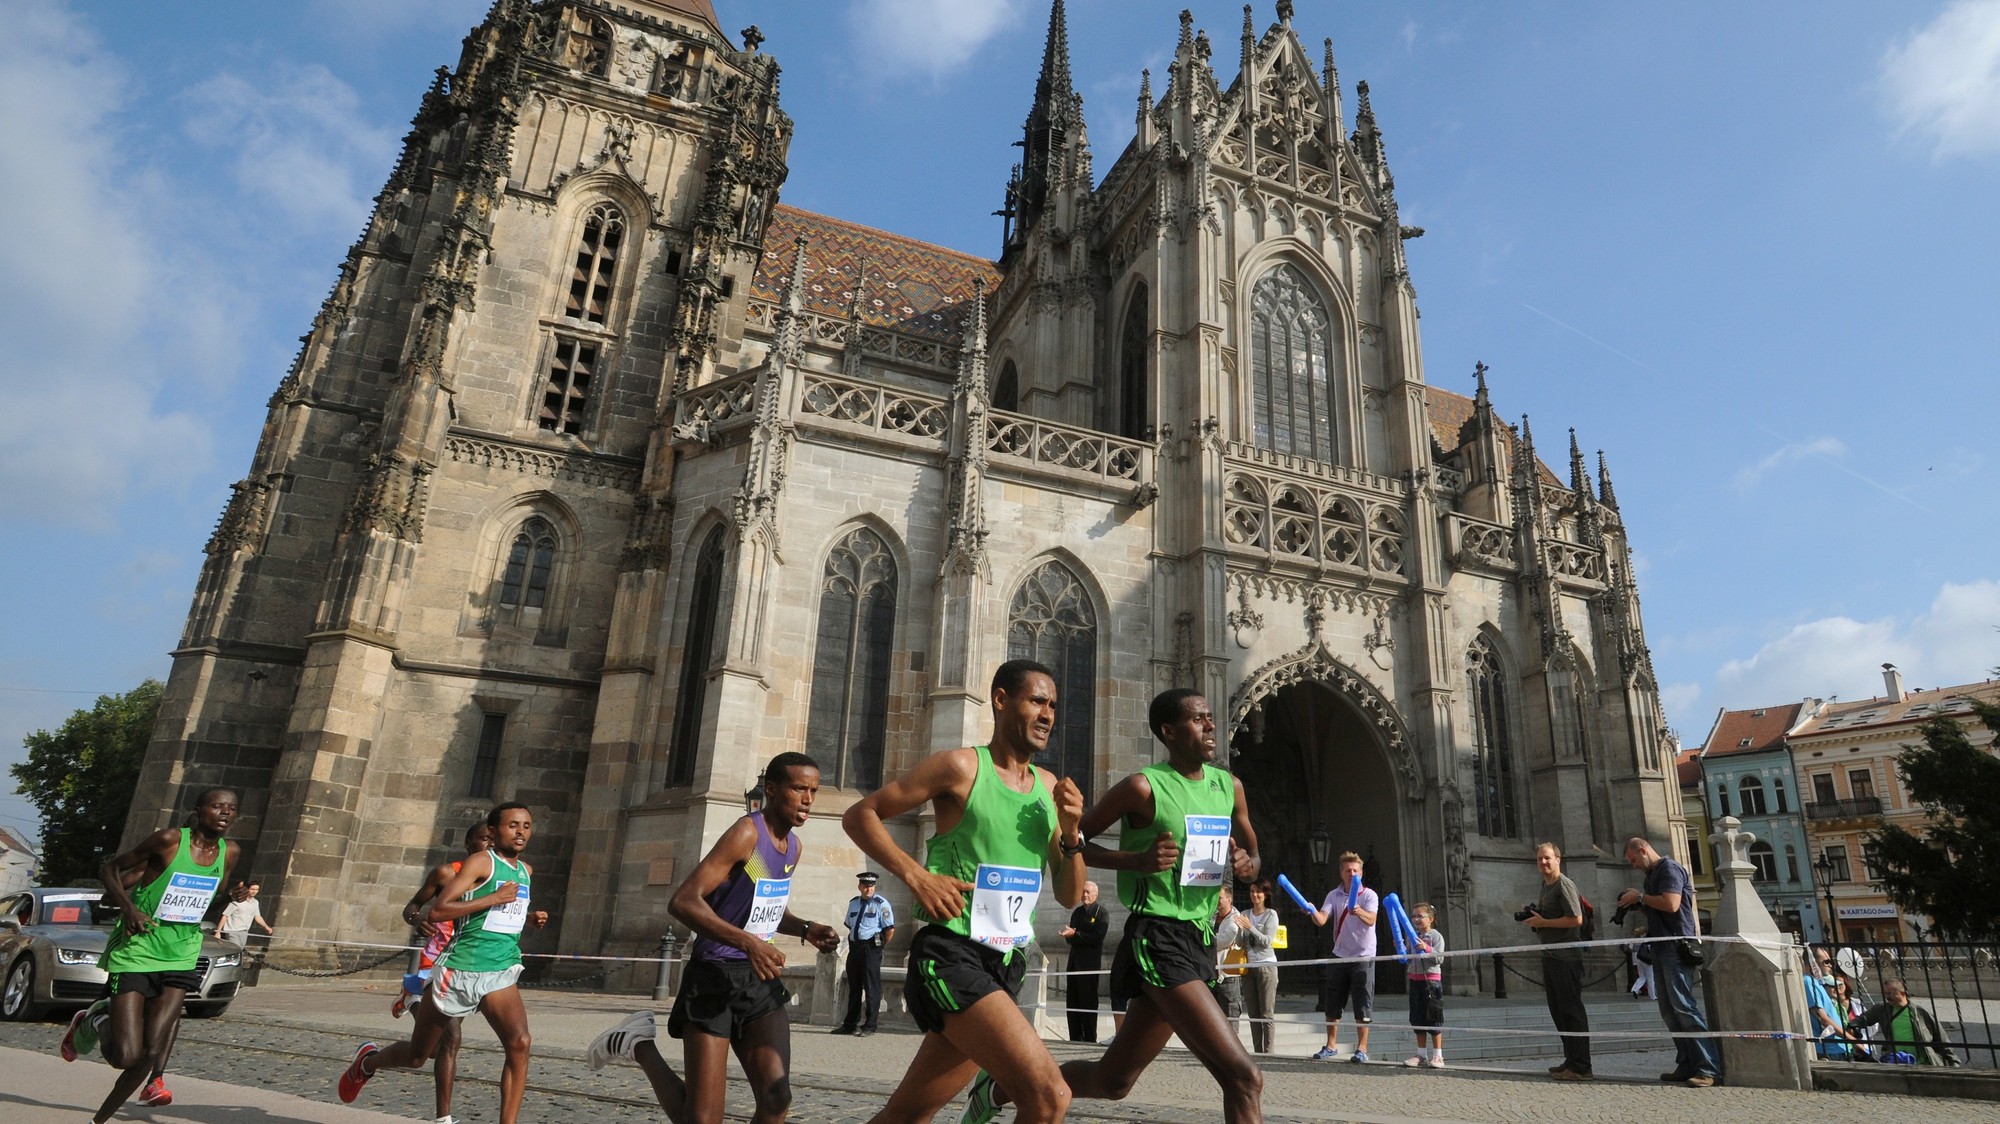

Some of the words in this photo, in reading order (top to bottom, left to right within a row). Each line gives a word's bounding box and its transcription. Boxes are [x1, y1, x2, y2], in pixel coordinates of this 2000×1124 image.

[1209, 839, 1221, 862] 11
[162, 893, 210, 909] BARTALE
[1007, 895, 1023, 923] 12
[1846, 908, 1877, 916] KARTAGO
[988, 935, 1028, 945] INTERSPORT
